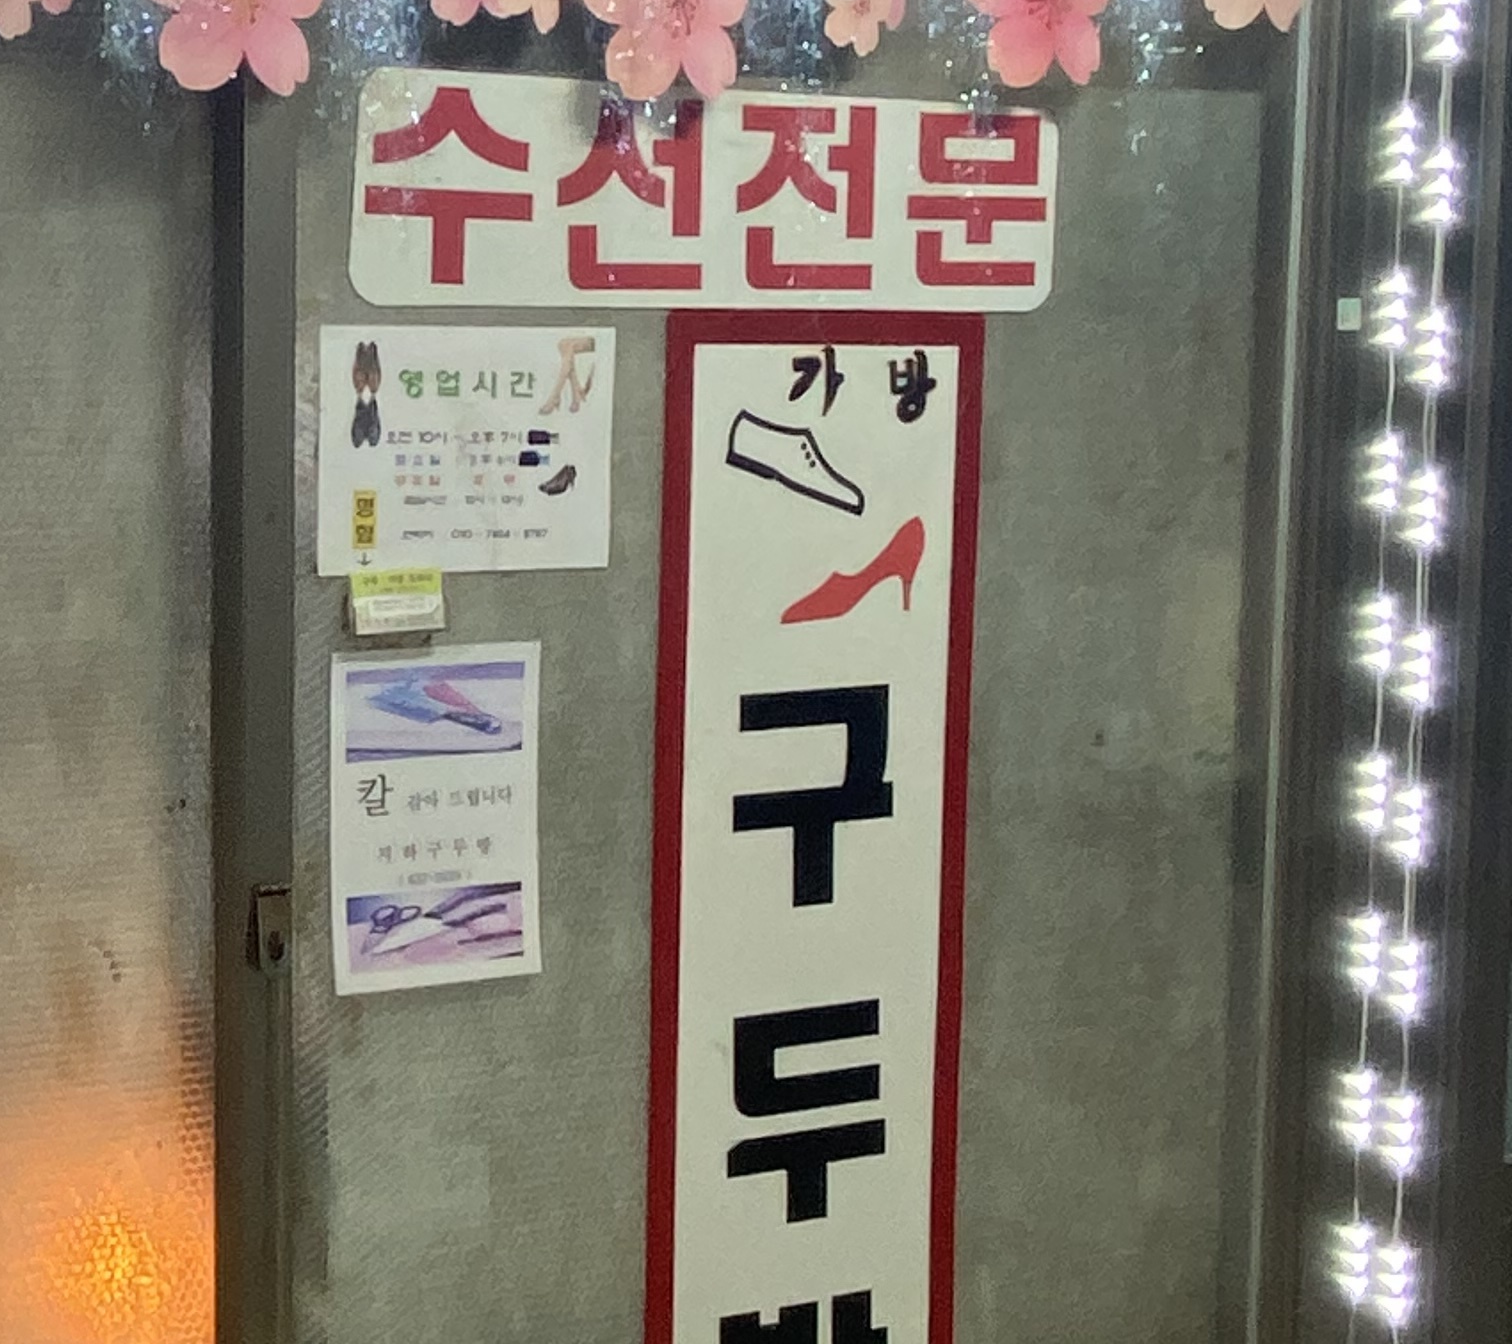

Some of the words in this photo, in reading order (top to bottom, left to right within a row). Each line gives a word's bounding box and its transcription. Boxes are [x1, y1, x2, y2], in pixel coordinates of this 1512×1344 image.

[365, 87, 1047, 291] 수선전문
[788, 344, 937, 423] 가방
[357, 774, 394, 816] 칼
